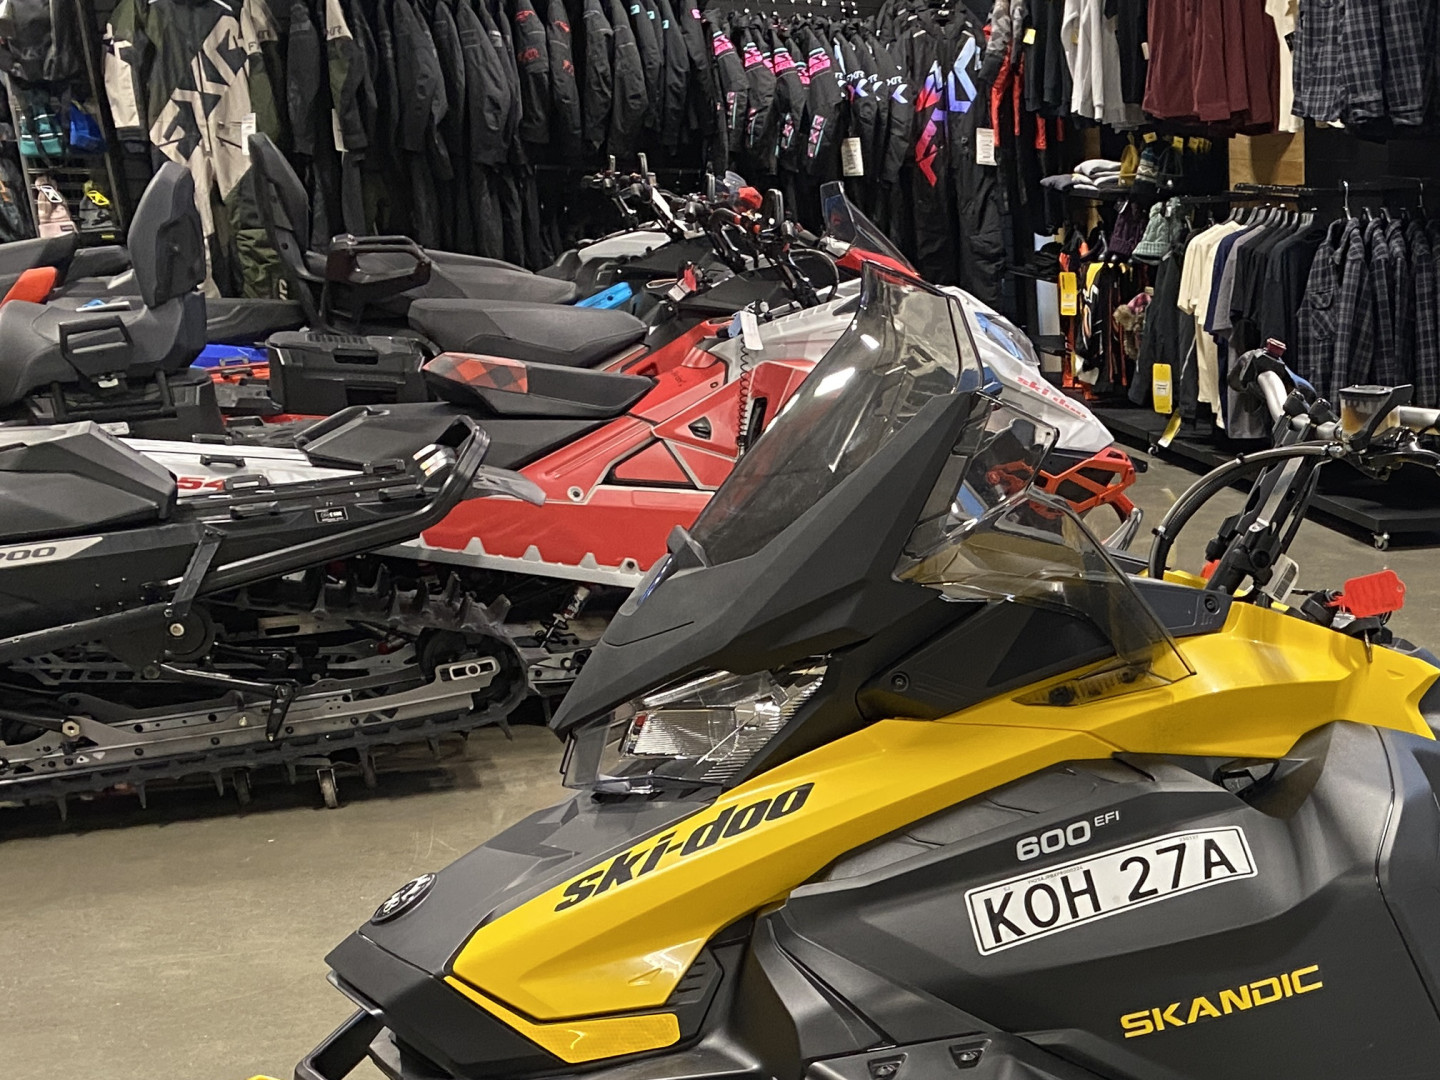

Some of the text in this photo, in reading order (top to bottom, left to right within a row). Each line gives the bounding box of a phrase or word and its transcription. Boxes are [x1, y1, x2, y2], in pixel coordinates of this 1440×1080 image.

[0, 546, 57, 561] 00
[1015, 810, 1120, 862] 600 EFI
[983, 838, 1238, 944] KOH 27A
[1120, 964, 1323, 1038] SKANDIC
